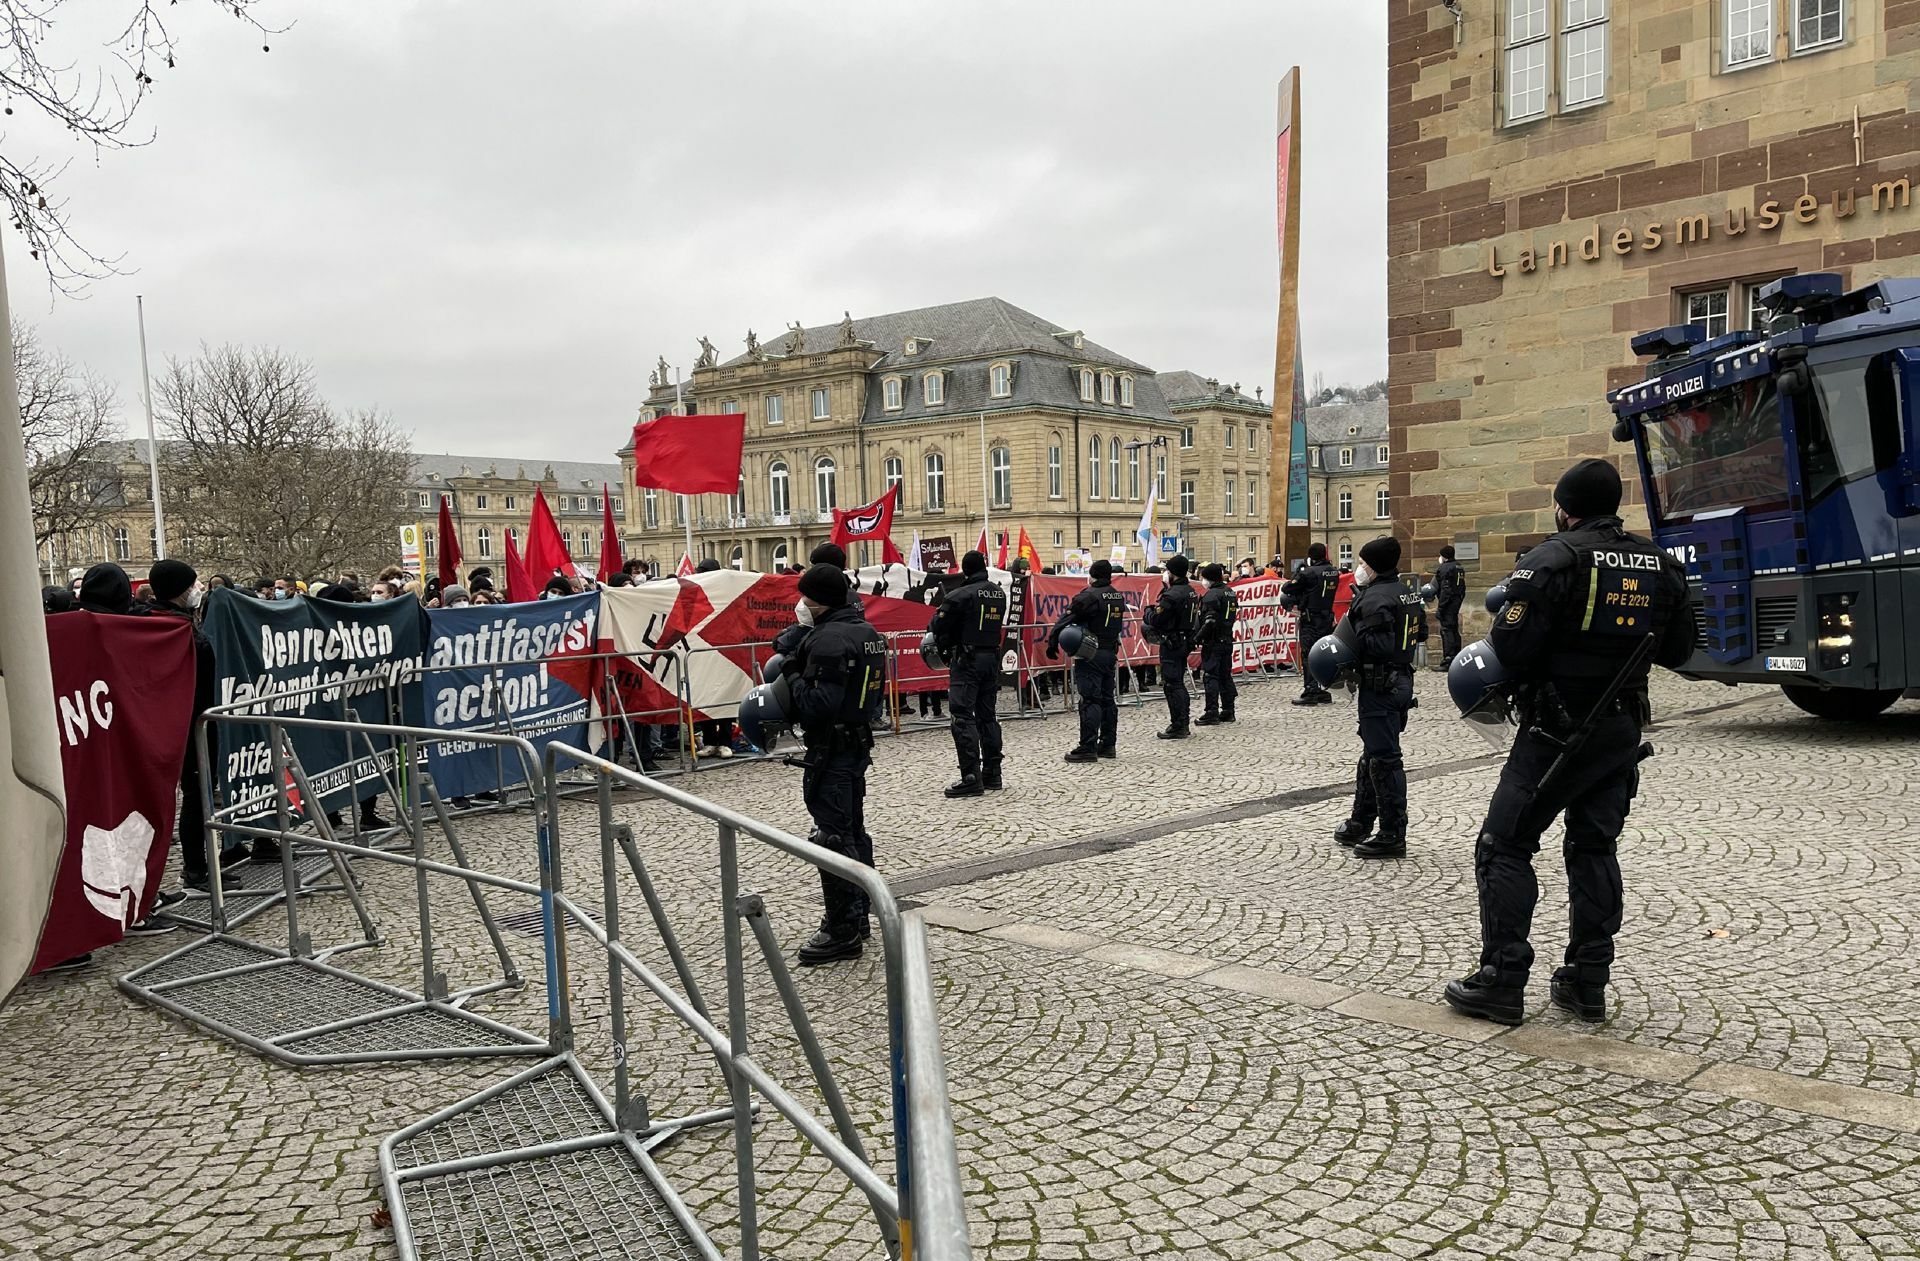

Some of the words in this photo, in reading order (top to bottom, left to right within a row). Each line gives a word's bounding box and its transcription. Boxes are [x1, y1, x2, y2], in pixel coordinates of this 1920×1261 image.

[1488, 177, 1911, 278] Landesmuseum
[1665, 375, 1704, 400] POLIZEI
[1592, 550, 1661, 571] POLIZEI
[1236, 584, 1281, 602] RAUEN
[1622, 578, 1638, 591] BW
[1605, 593, 1620, 606] PP
[261, 624, 300, 669] Den
[303, 620, 393, 663] rechten
[430, 609, 597, 674] antifascist
[433, 662, 549, 727] action!
